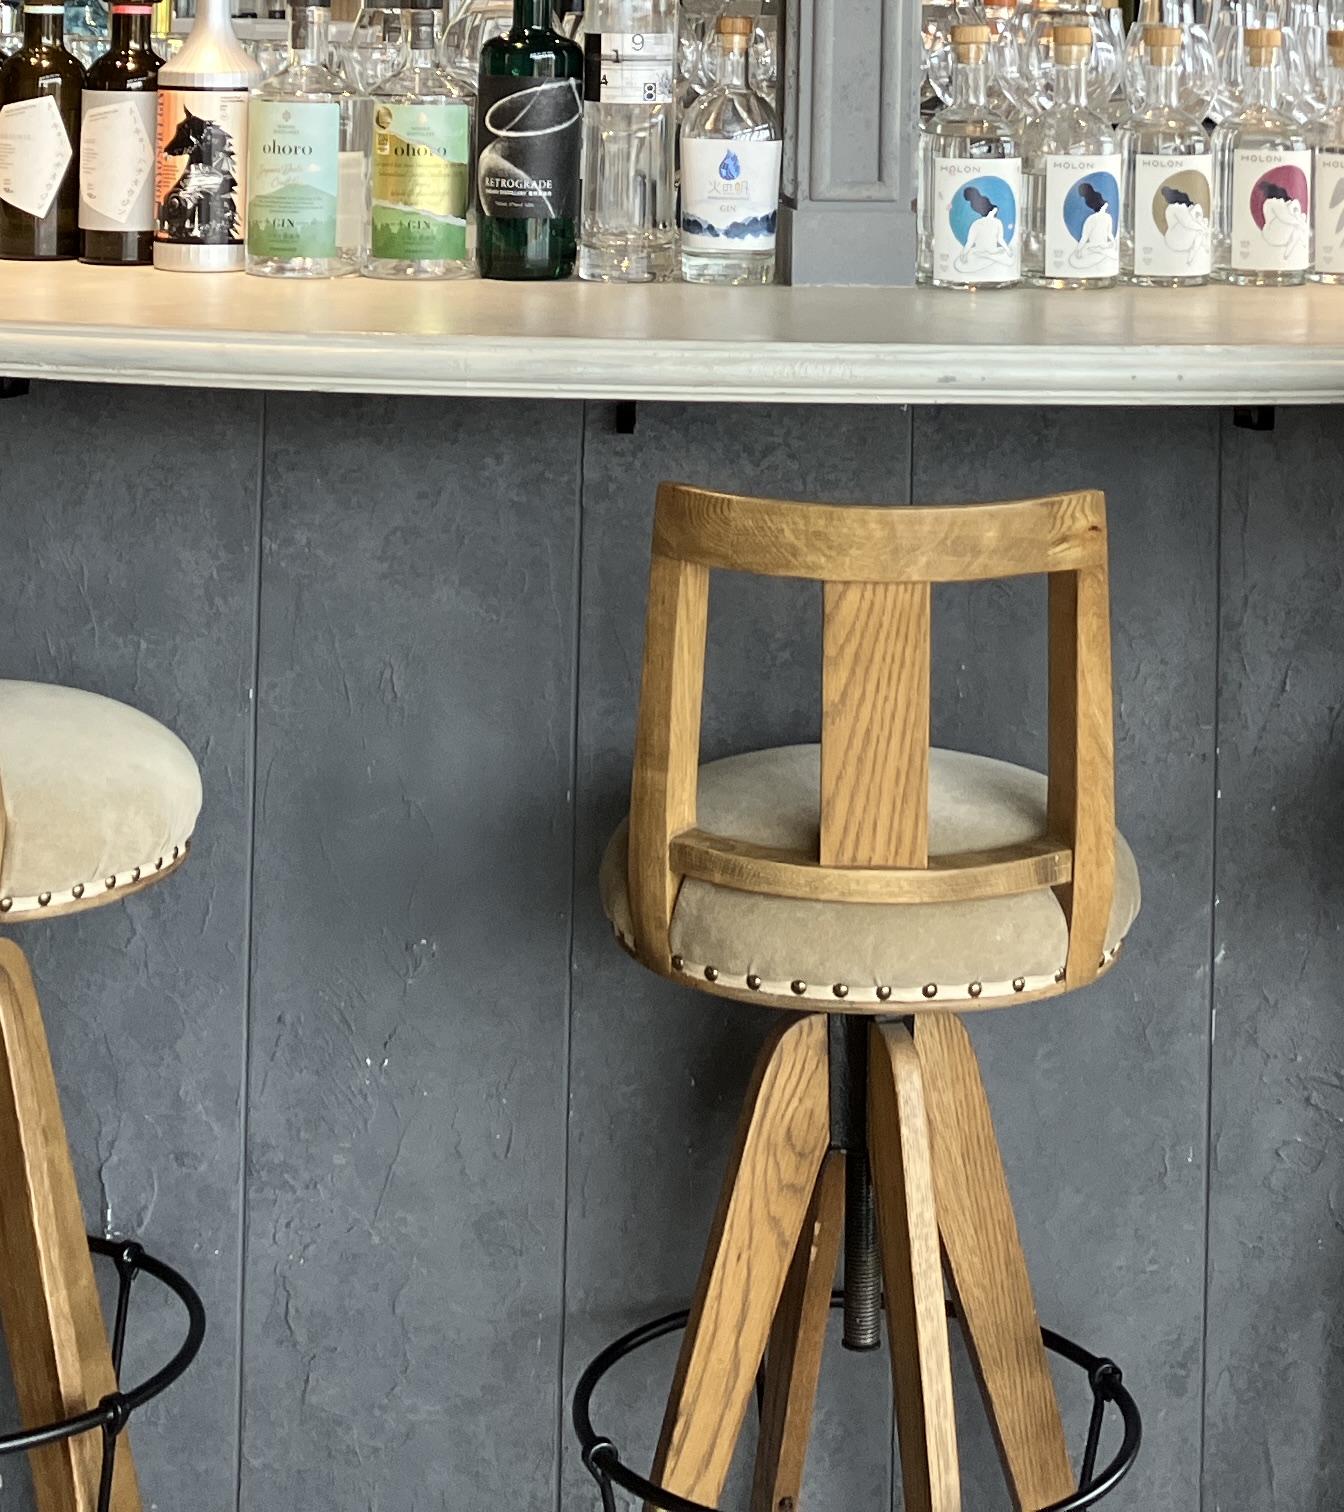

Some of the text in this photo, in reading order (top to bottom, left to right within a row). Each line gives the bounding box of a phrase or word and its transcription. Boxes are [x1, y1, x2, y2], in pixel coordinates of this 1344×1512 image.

[632, 34, 645, 52] 9
[644, 83, 656, 101] 8
[262, 139, 313, 156] ohoro
[1241, 154, 1282, 163] HOLON
[1053, 161, 1094, 169] HOLON
[1142, 160, 1184, 168] HOLON
[940, 165, 981, 173] HOLON
[485, 177, 553, 189] RETROGRADE
[719, 204, 736, 213] GIN
[272, 218, 295, 228] GIN
